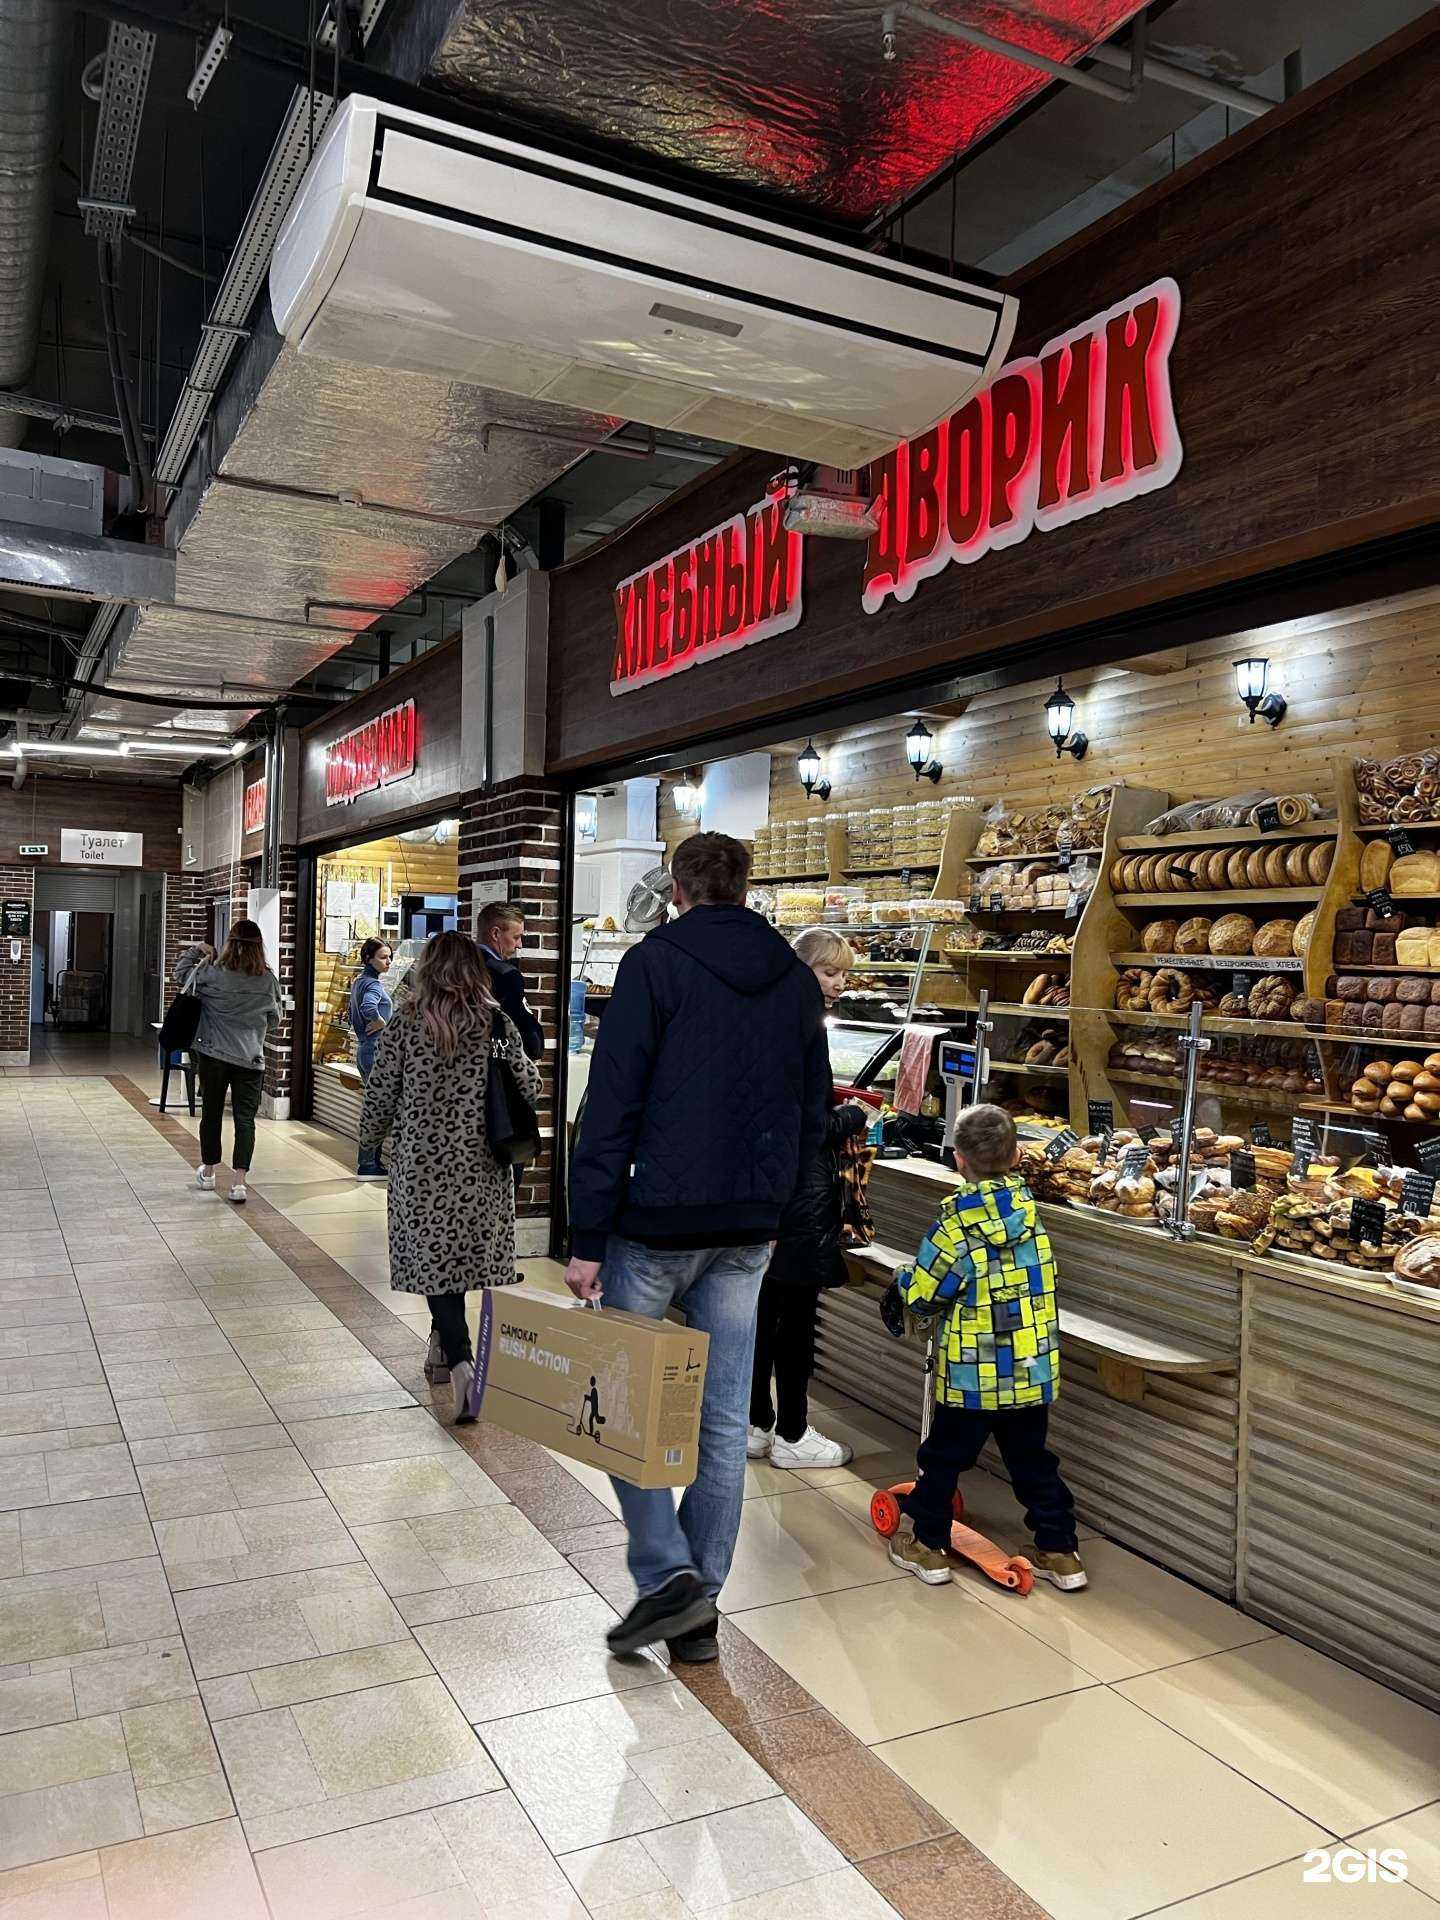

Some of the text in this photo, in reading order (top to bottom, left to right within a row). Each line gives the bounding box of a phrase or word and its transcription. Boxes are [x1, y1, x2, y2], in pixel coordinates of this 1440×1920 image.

[613, 296, 1159, 681] ХЛЕБНЫЙ ДВОРИК
[80, 833, 125, 849] Туалет
[80, 850, 104, 860] Toilet
[1276, 961, 1302, 969] ХЛЕБА
[500, 1323, 539, 1345] САМОКАТ
[528, 1346, 571, 1375] ACTION
